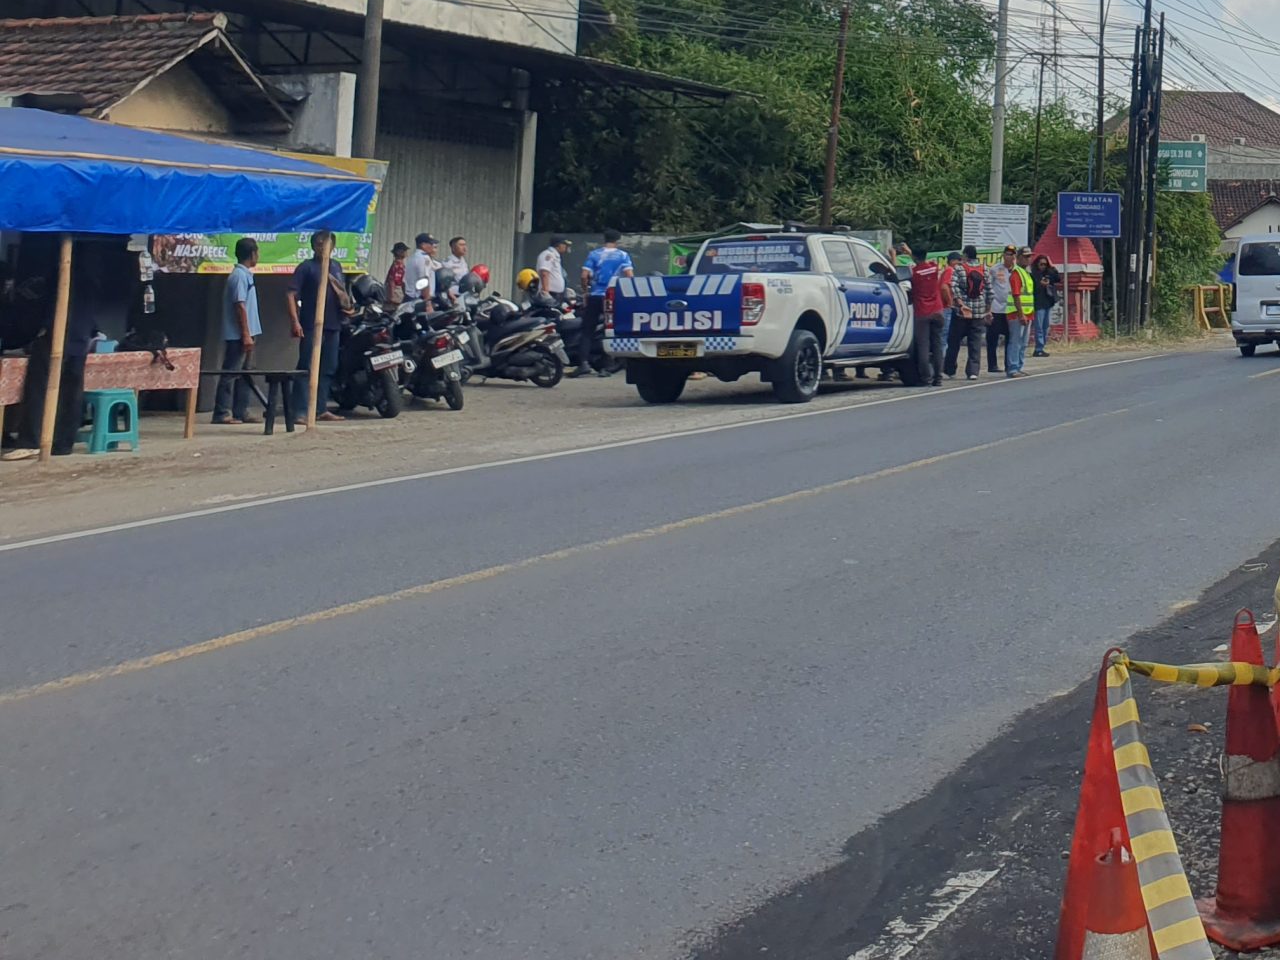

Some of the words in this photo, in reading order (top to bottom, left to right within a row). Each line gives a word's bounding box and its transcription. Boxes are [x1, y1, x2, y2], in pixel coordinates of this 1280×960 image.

[1073, 196, 1113, 204] JEMBATAN
[173, 244, 201, 257] NASI
[202, 245, 229, 257] PECEL
[717, 246, 756, 256] MUDIK
[849, 303, 880, 319] POLISI
[632, 310, 722, 332] POLISI
